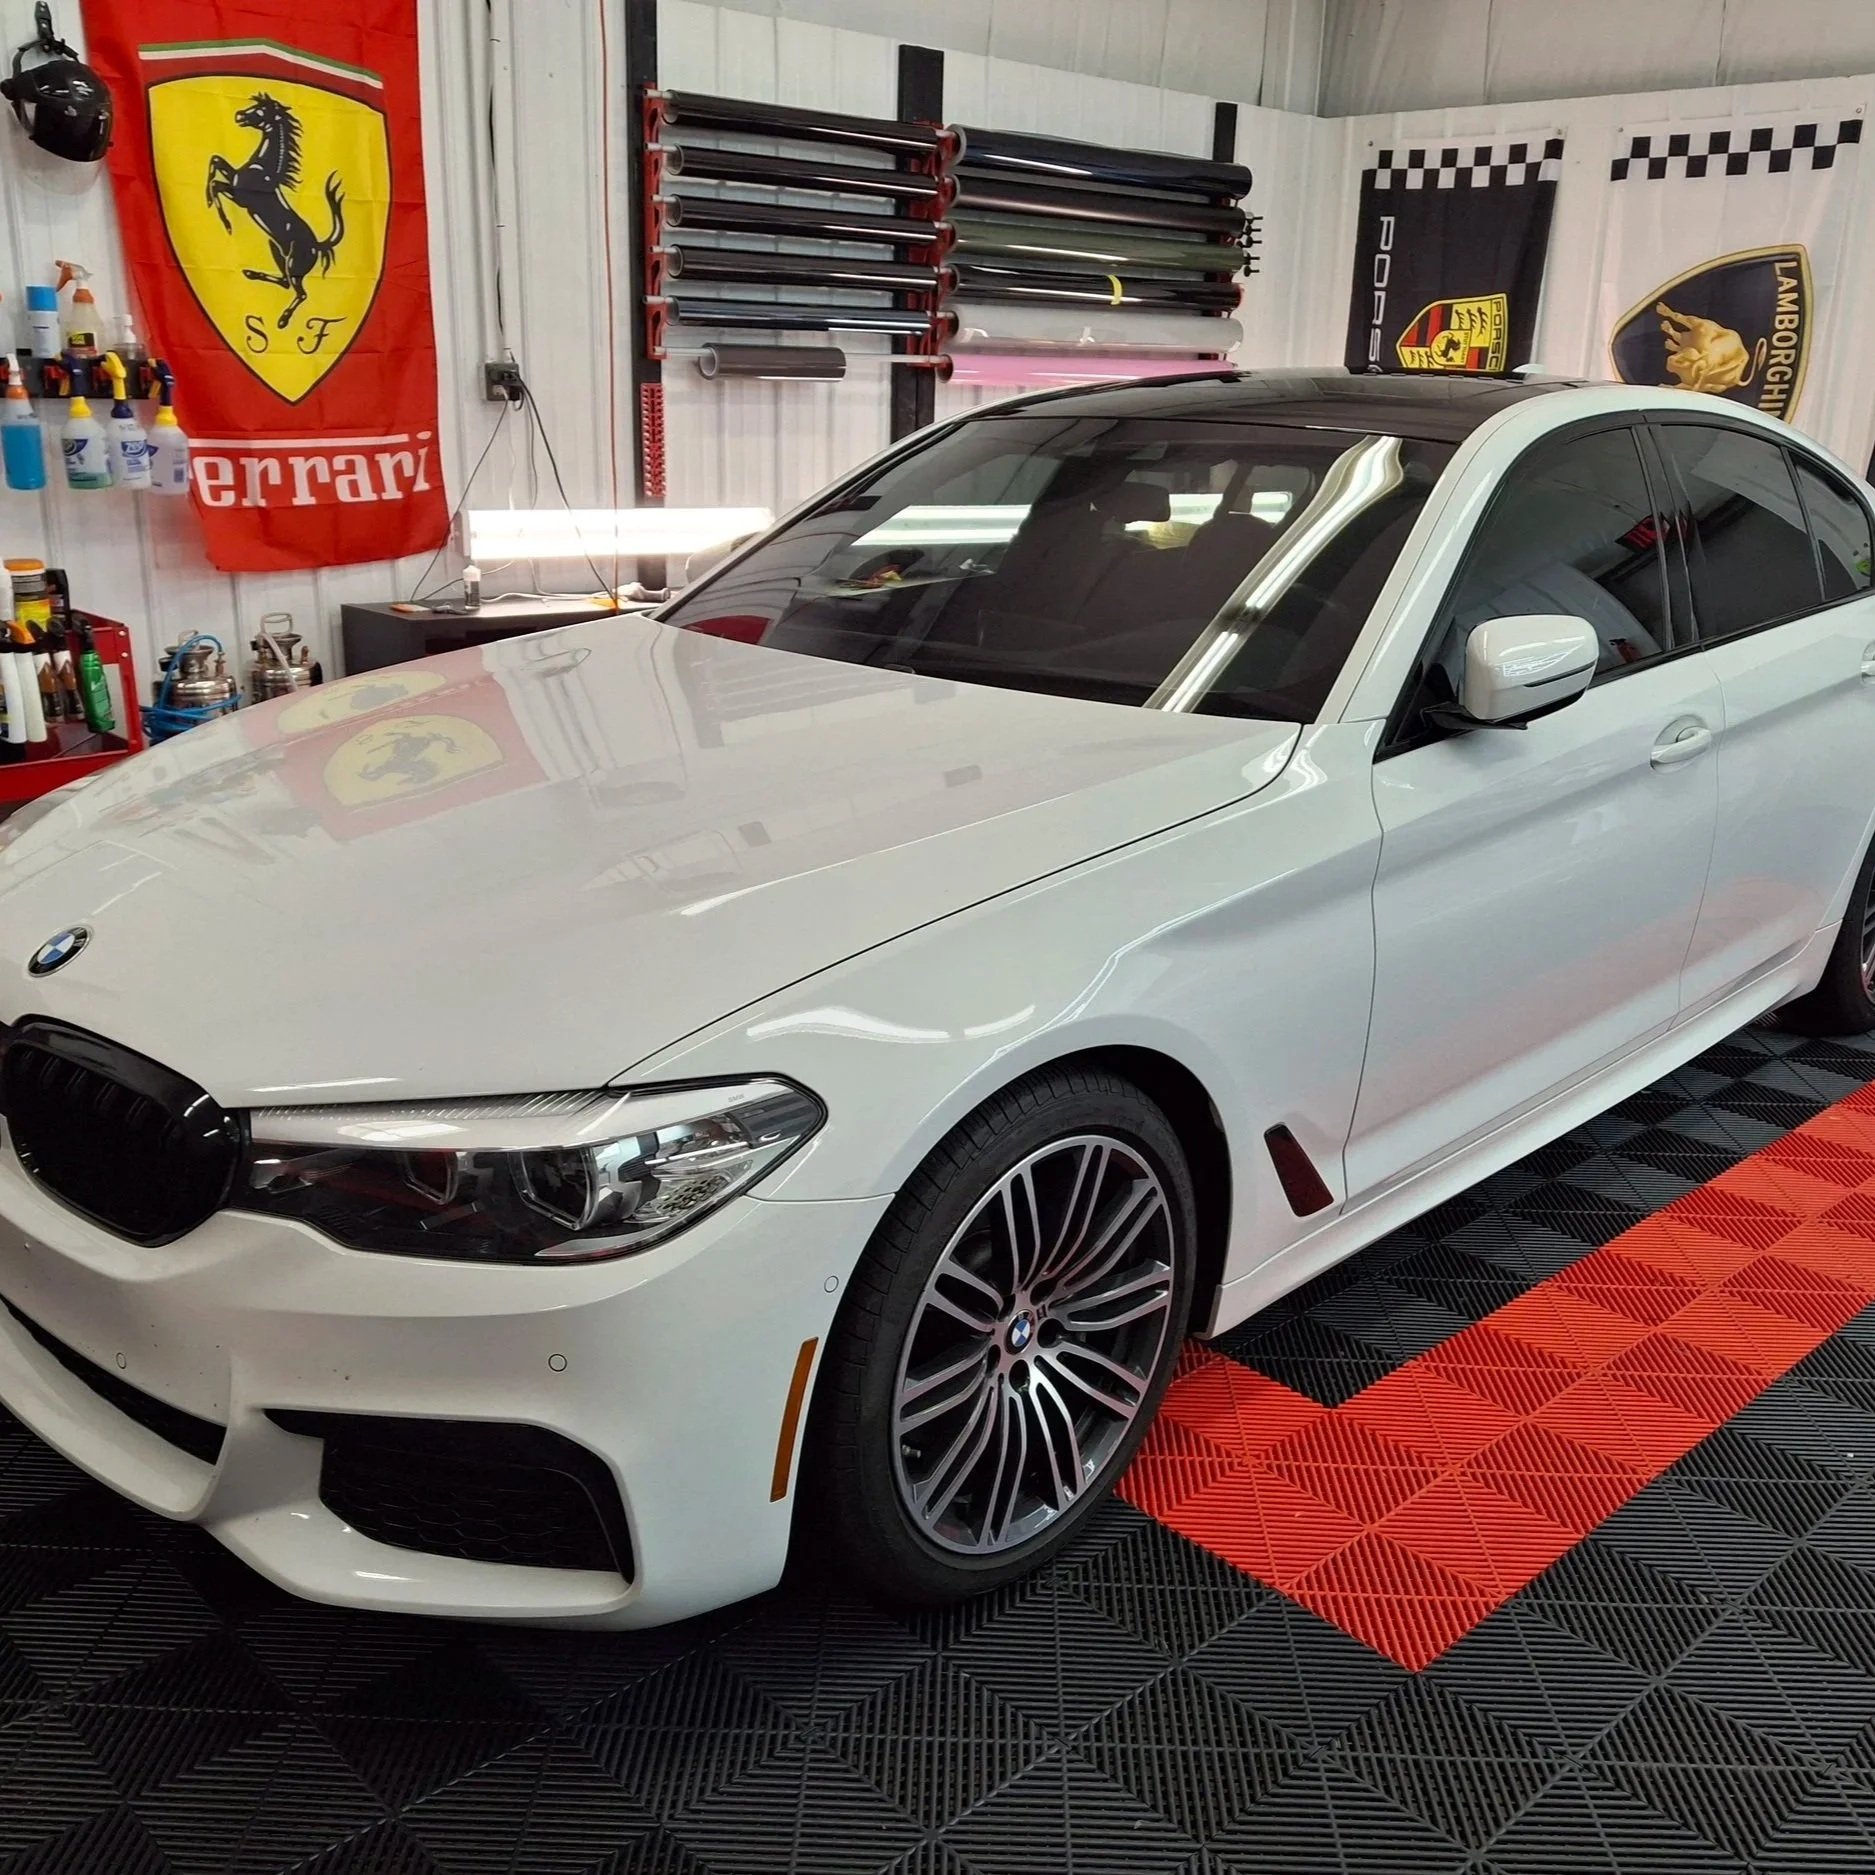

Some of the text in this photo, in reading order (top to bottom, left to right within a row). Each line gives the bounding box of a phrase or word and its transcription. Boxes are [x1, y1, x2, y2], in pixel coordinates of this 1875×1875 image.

[1368, 216, 1395, 372] PORS
[244, 315, 348, 355] S F
[188, 431, 433, 508] errari
